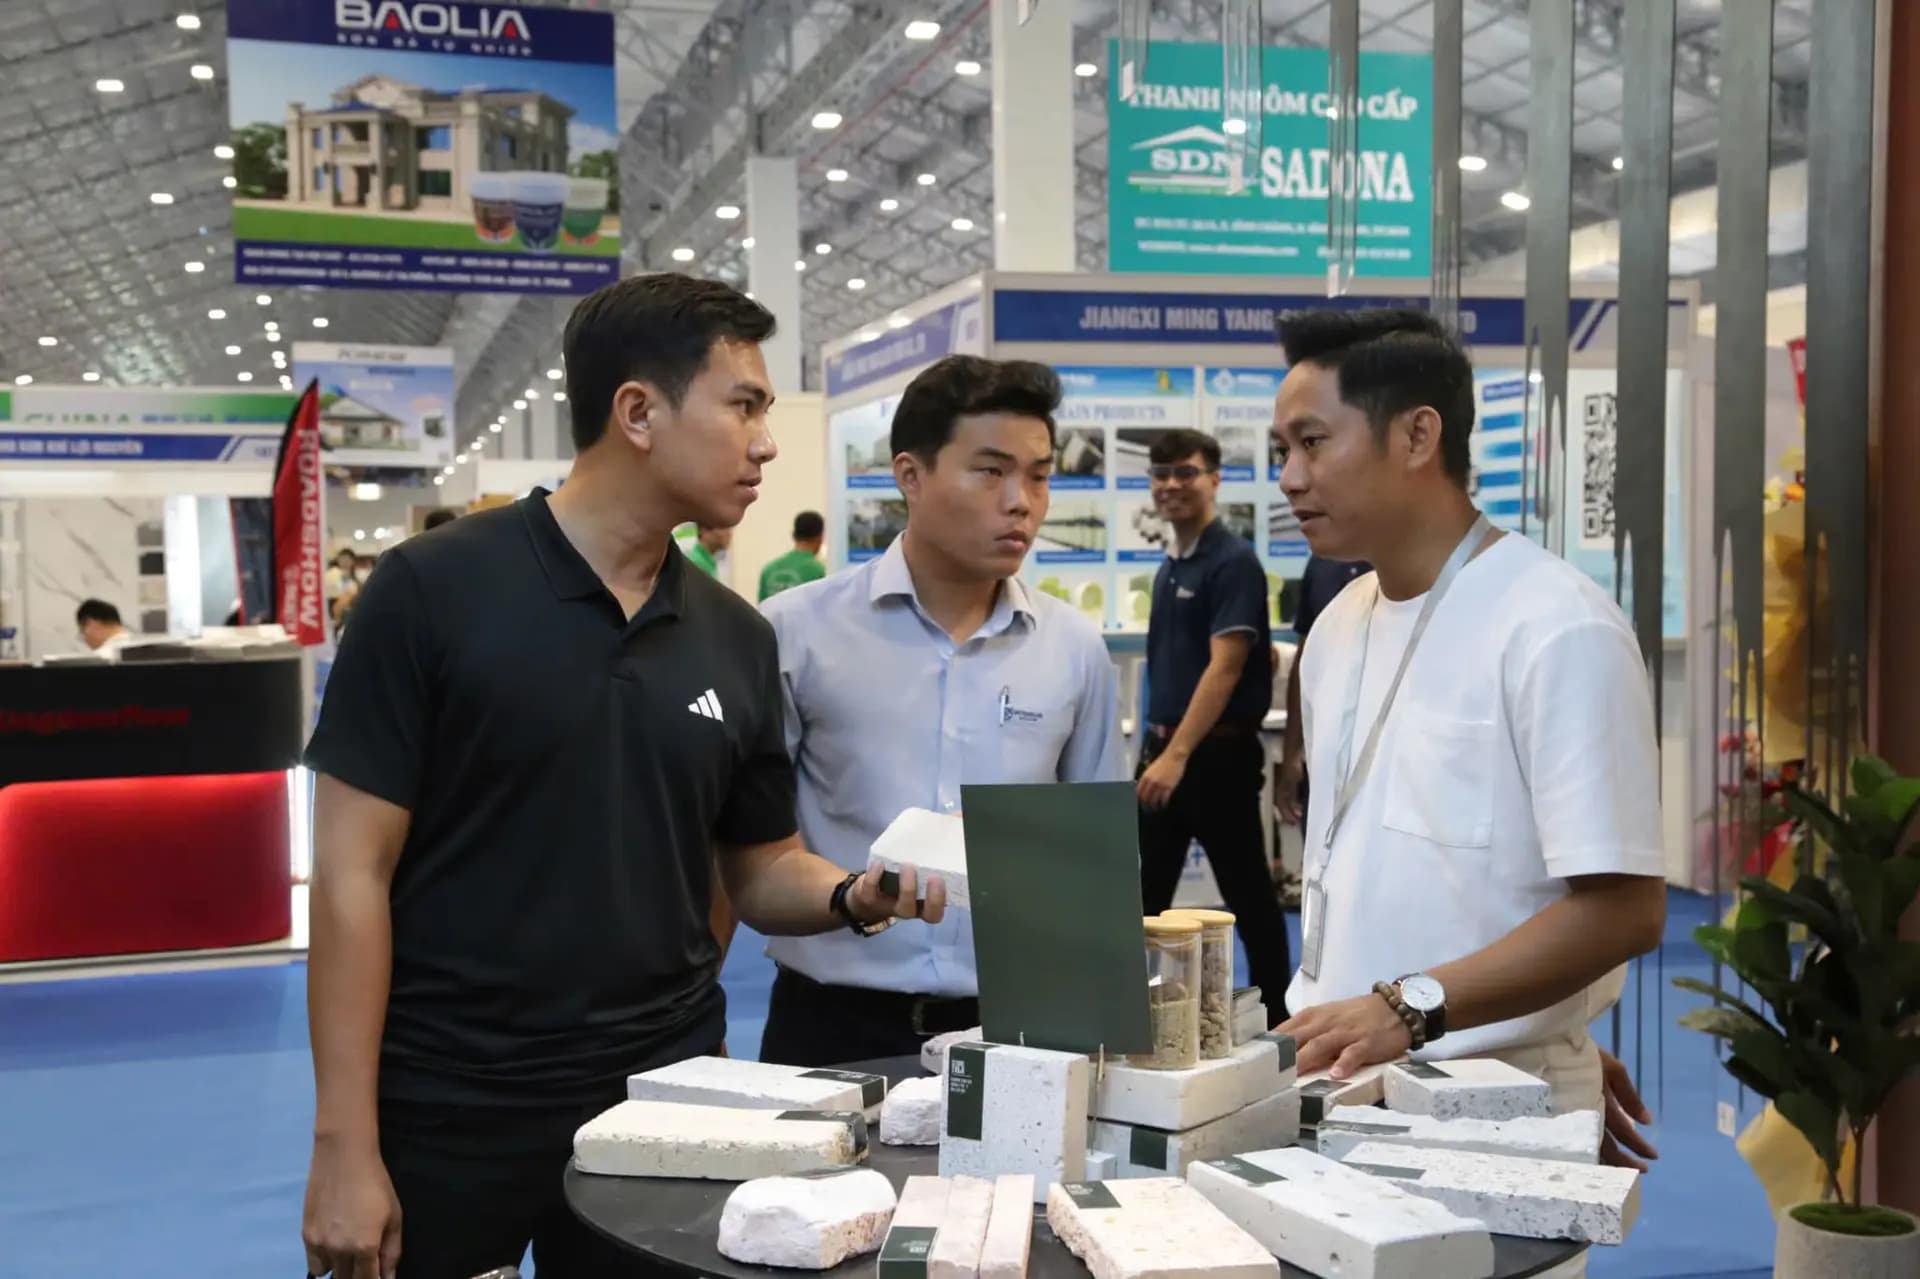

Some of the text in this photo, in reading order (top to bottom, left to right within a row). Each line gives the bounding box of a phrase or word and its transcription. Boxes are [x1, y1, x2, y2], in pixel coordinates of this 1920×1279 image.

[335, 0, 531, 41] BAOLIA
[1128, 83, 1222, 112] THANH
[1080, 306, 1161, 330] JIANGXI
[1166, 307, 1219, 331] MING
[1224, 308, 1275, 332] YANG
[297, 428, 320, 630] ROADSHOW
